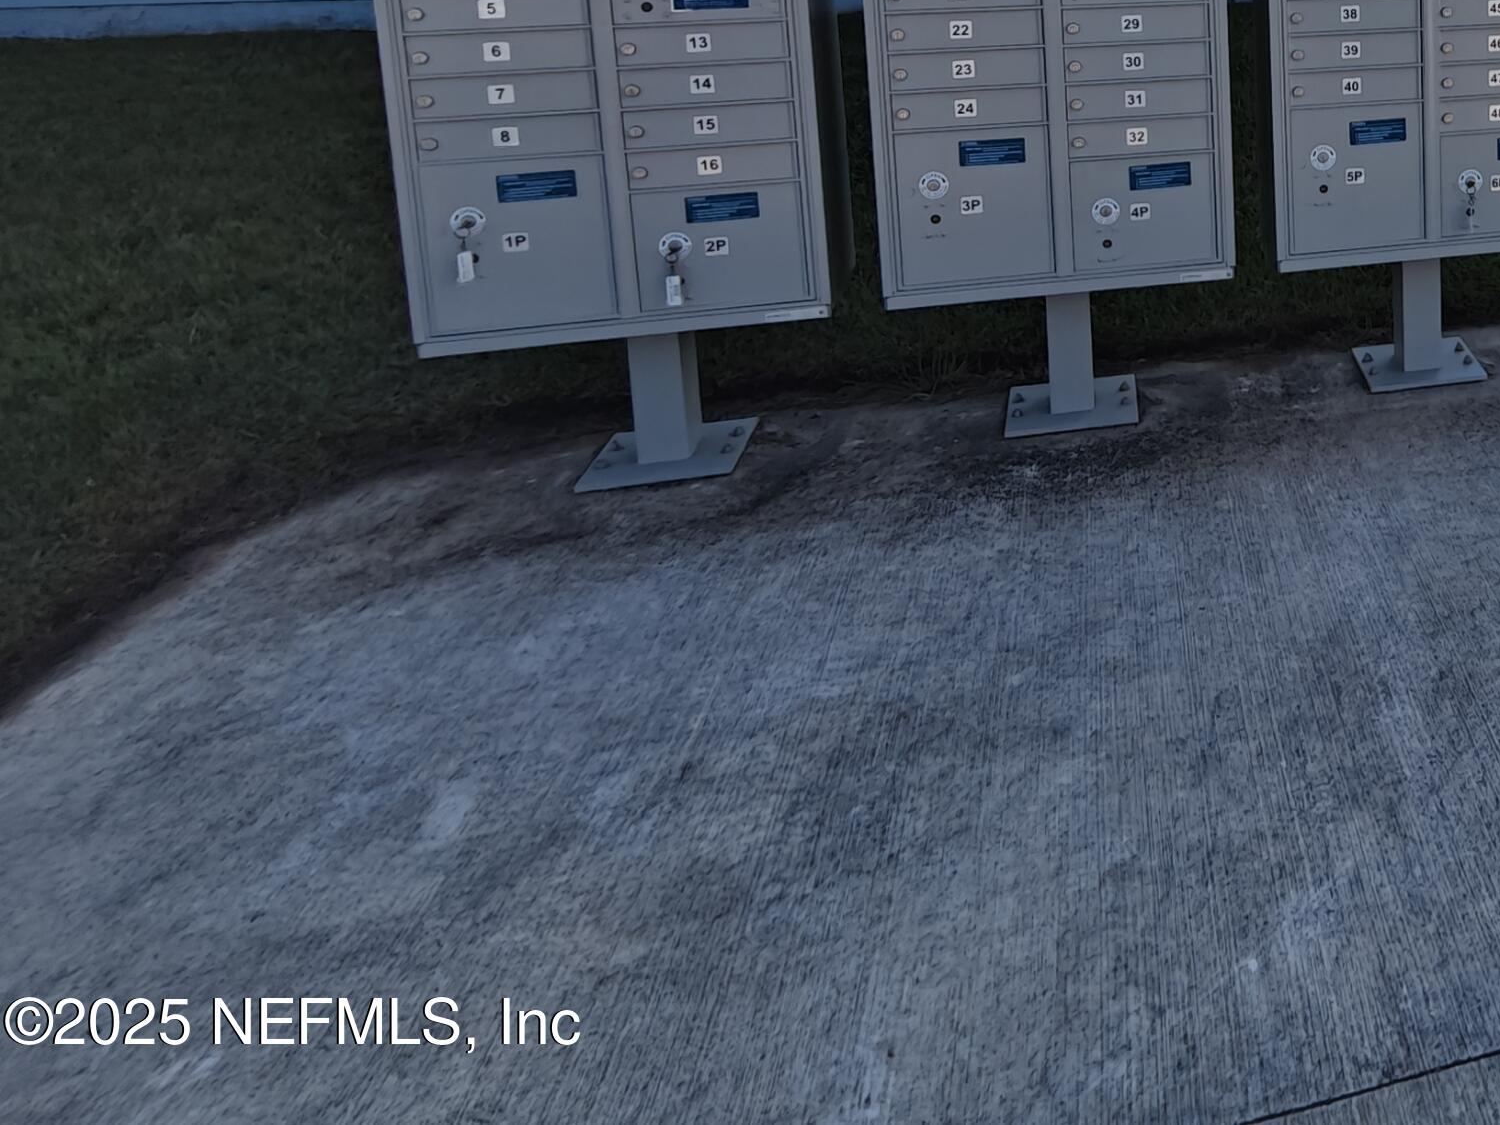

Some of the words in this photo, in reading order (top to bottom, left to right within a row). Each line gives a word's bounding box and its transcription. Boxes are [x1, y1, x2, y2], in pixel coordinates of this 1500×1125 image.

[486, 2, 497, 15] 5
[1342, 8, 1358, 20] 38
[952, 24, 969, 36] 22
[1123, 18, 1140, 30] 29
[689, 36, 708, 49] 13
[490, 44, 502, 58] 6
[1343, 45, 1359, 56] 39
[1125, 56, 1142, 68] 30
[954, 63, 972, 76] 23
[692, 77, 712, 90] 14
[1344, 81, 1359, 92] 40
[494, 87, 505, 100] 7
[1127, 93, 1142, 106] 31
[957, 103, 974, 115] 24
[696, 118, 716, 131] 15
[500, 130, 511, 143] 8
[1129, 131, 1145, 143] 32
[700, 158, 719, 171] 16
[1347, 170, 1363, 182] 5P
[962, 199, 981, 212] 3P
[1130, 206, 1149, 218] 4P
[505, 235, 527, 248] 1P
[706, 239, 726, 253] 2P
